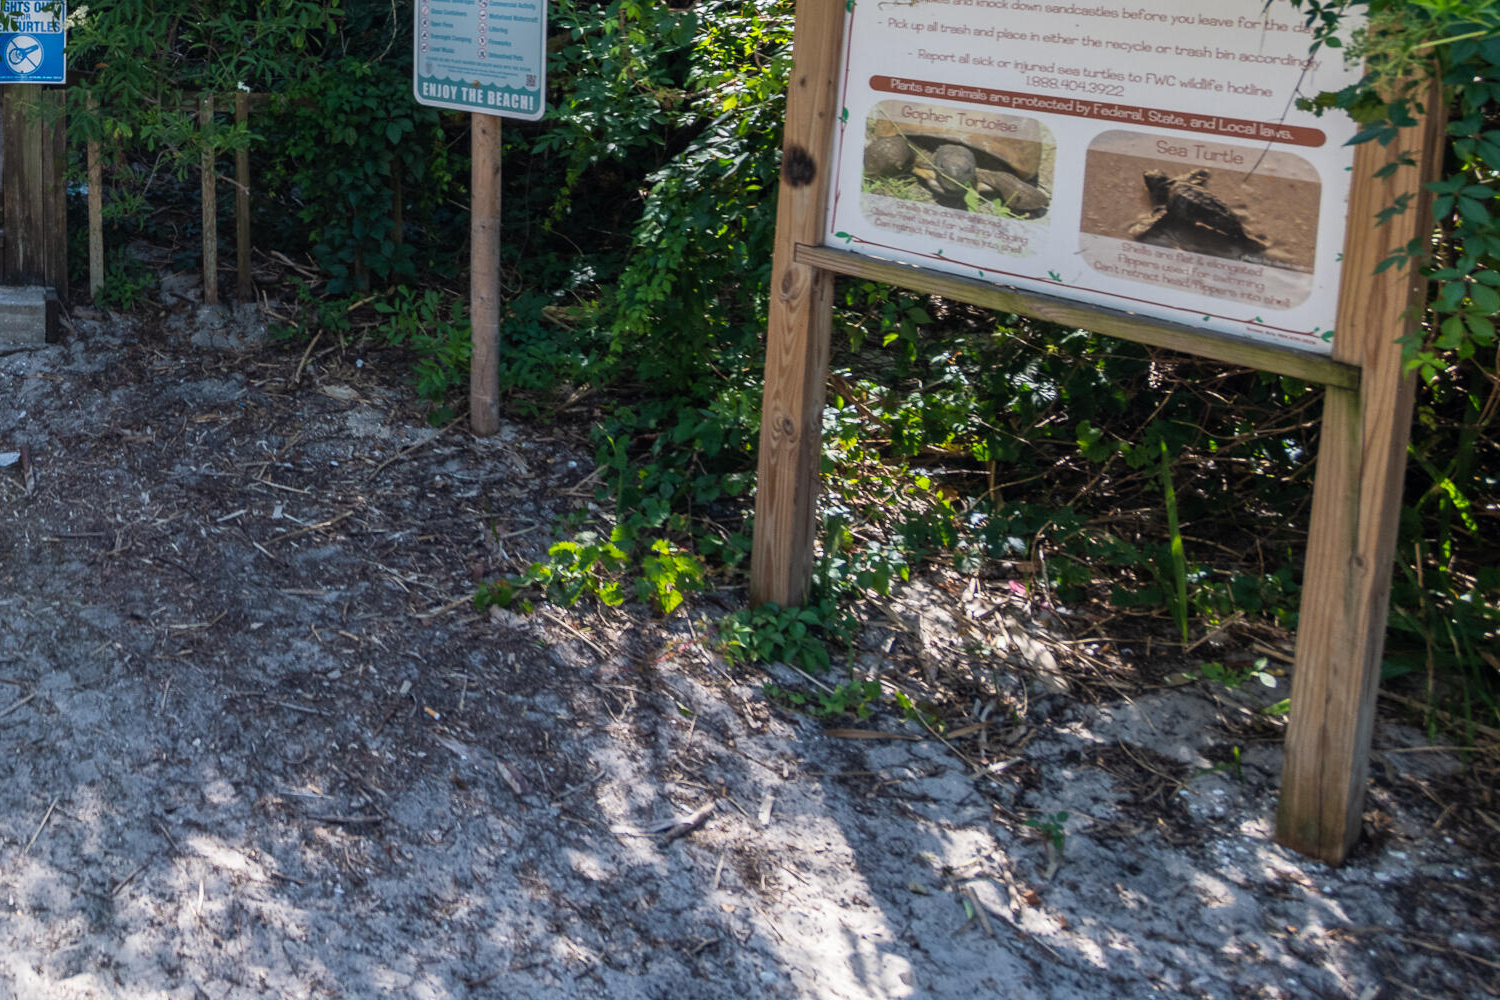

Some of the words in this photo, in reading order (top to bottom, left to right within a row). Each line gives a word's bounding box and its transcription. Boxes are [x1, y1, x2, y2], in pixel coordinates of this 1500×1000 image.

[19, 21, 60, 32] URTLES
[1011, 0, 1042, 12] down
[1045, 3, 1119, 18] sandcastles
[1122, 8, 1168, 22] before
[1171, 16, 1195, 26] you
[1198, 14, 1233, 27] leave
[1238, 16, 1261, 28] for
[1264, 19, 1288, 31] the
[888, 17, 908, 29] Pick
[911, 23, 925, 34] up
[927, 22, 938, 32] all
[940, 24, 971, 36] trash
[973, 27, 995, 38] and
[997, 28, 1027, 41] place
[1030, 32, 1040, 41] in
[1042, 32, 1078, 45] either
[1082, 36, 1102, 48] the
[1105, 41, 1152, 53] recycle
[1155, 46, 1171, 54] or
[1175, 46, 1212, 58] trash
[1216, 48, 1235, 60] bin
[1239, 53, 1322, 72] accordingly
[918, 49, 956, 64] Report
[959, 54, 969, 64] all
[972, 56, 994, 68] sick
[1000, 60, 1011, 69] or
[1014, 60, 1055, 74] injured
[1058, 66, 1080, 77] sea
[1083, 68, 1125, 81] turtles
[1129, 73, 1141, 83] to
[1145, 73, 1176, 87] FWC
[1179, 76, 1224, 91] wildlife
[1227, 80, 1273, 97] hotline
[1027, 76, 1124, 96] 1.888.404.3922
[423, 82, 458, 100] ENJOY
[461, 87, 483, 103] THE
[487, 90, 534, 111] BEACH!
[890, 77, 922, 92] Plants
[924, 83, 946, 95] and
[947, 86, 988, 100] animals
[990, 93, 1010, 103] are
[1012, 95, 1074, 112] protected
[1076, 101, 1091, 115] by
[1190, 117, 1215, 130] and
[1218, 119, 1256, 136] Local
[901, 105, 952, 126] Gopher
[957, 112, 1018, 133] Tortoise
[1155, 139, 1188, 158] Sea
[1193, 144, 1244, 165] Turtle
[1121, 242, 1152, 257] Shells
[1155, 251, 1173, 260] are
[1118, 253, 1159, 270] Flippers
[1162, 265, 1188, 275] used
[1191, 267, 1210, 278] for
[1121, 268, 1159, 282] retract
